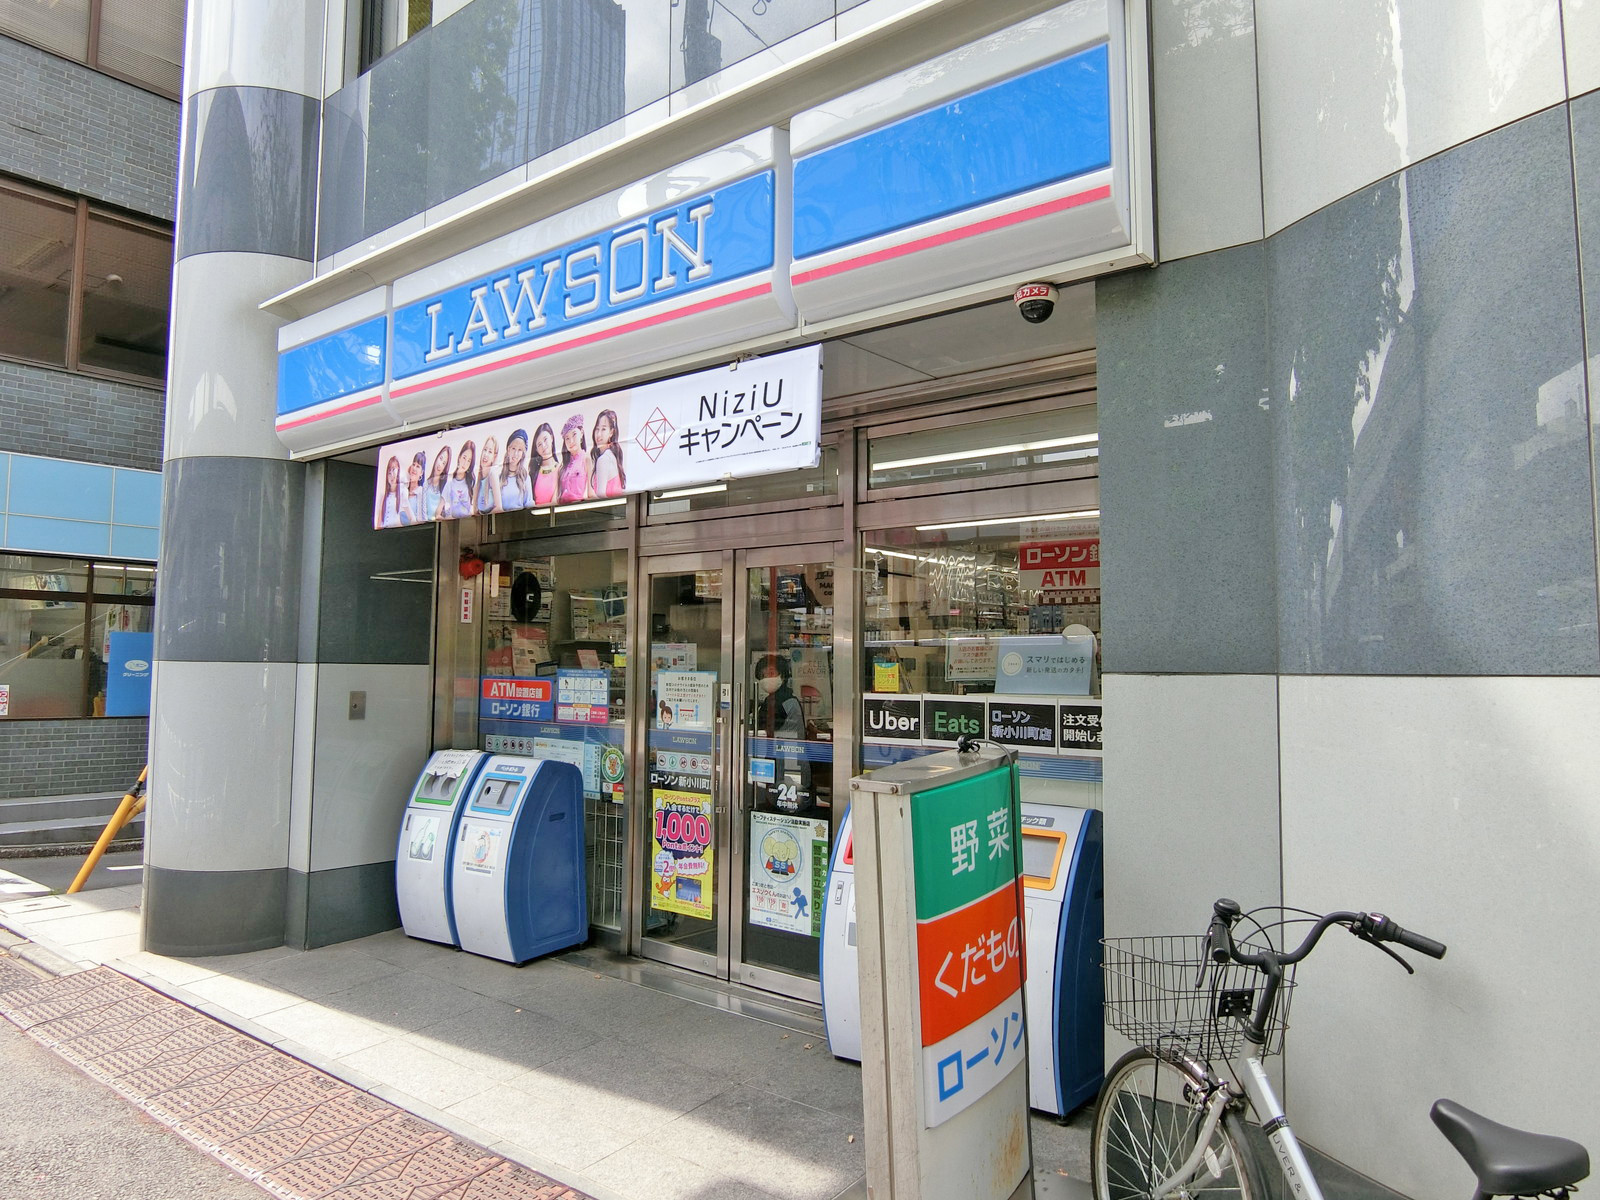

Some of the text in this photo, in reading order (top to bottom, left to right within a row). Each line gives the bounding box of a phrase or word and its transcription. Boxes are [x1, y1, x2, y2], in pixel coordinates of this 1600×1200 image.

[424, 202, 715, 362] LAWSON
[1014, 287, 1048, 303] 犯カメラ
[699, 379, 783, 422] NiziU
[679, 412, 803, 456] キャンペーン
[1041, 570, 1087, 587] ATM
[1026, 655, 1085, 664] スマリではじめる
[491, 702, 540, 718] ローソン銀行
[991, 710, 1031, 724] ローソン
[869, 710, 980, 734] Uber Eats
[672, 736, 697, 744] LAWSON
[991, 725, 1052, 742] 新小川町店
[775, 744, 805, 753] LAWSON
[650, 773, 712, 790] ローソン新小川町
[778, 783, 798, 801] 24
[666, 802, 700, 814] 入会するだけで
[776, 800, 799, 809] 年中無休
[655, 810, 711, 846] 1,000
[950, 806, 1011, 877] 野菜
[775, 860, 786, 870] SS
[933, 915, 1025, 998] くだもの
[937, 1011, 1026, 1103] ローソン
